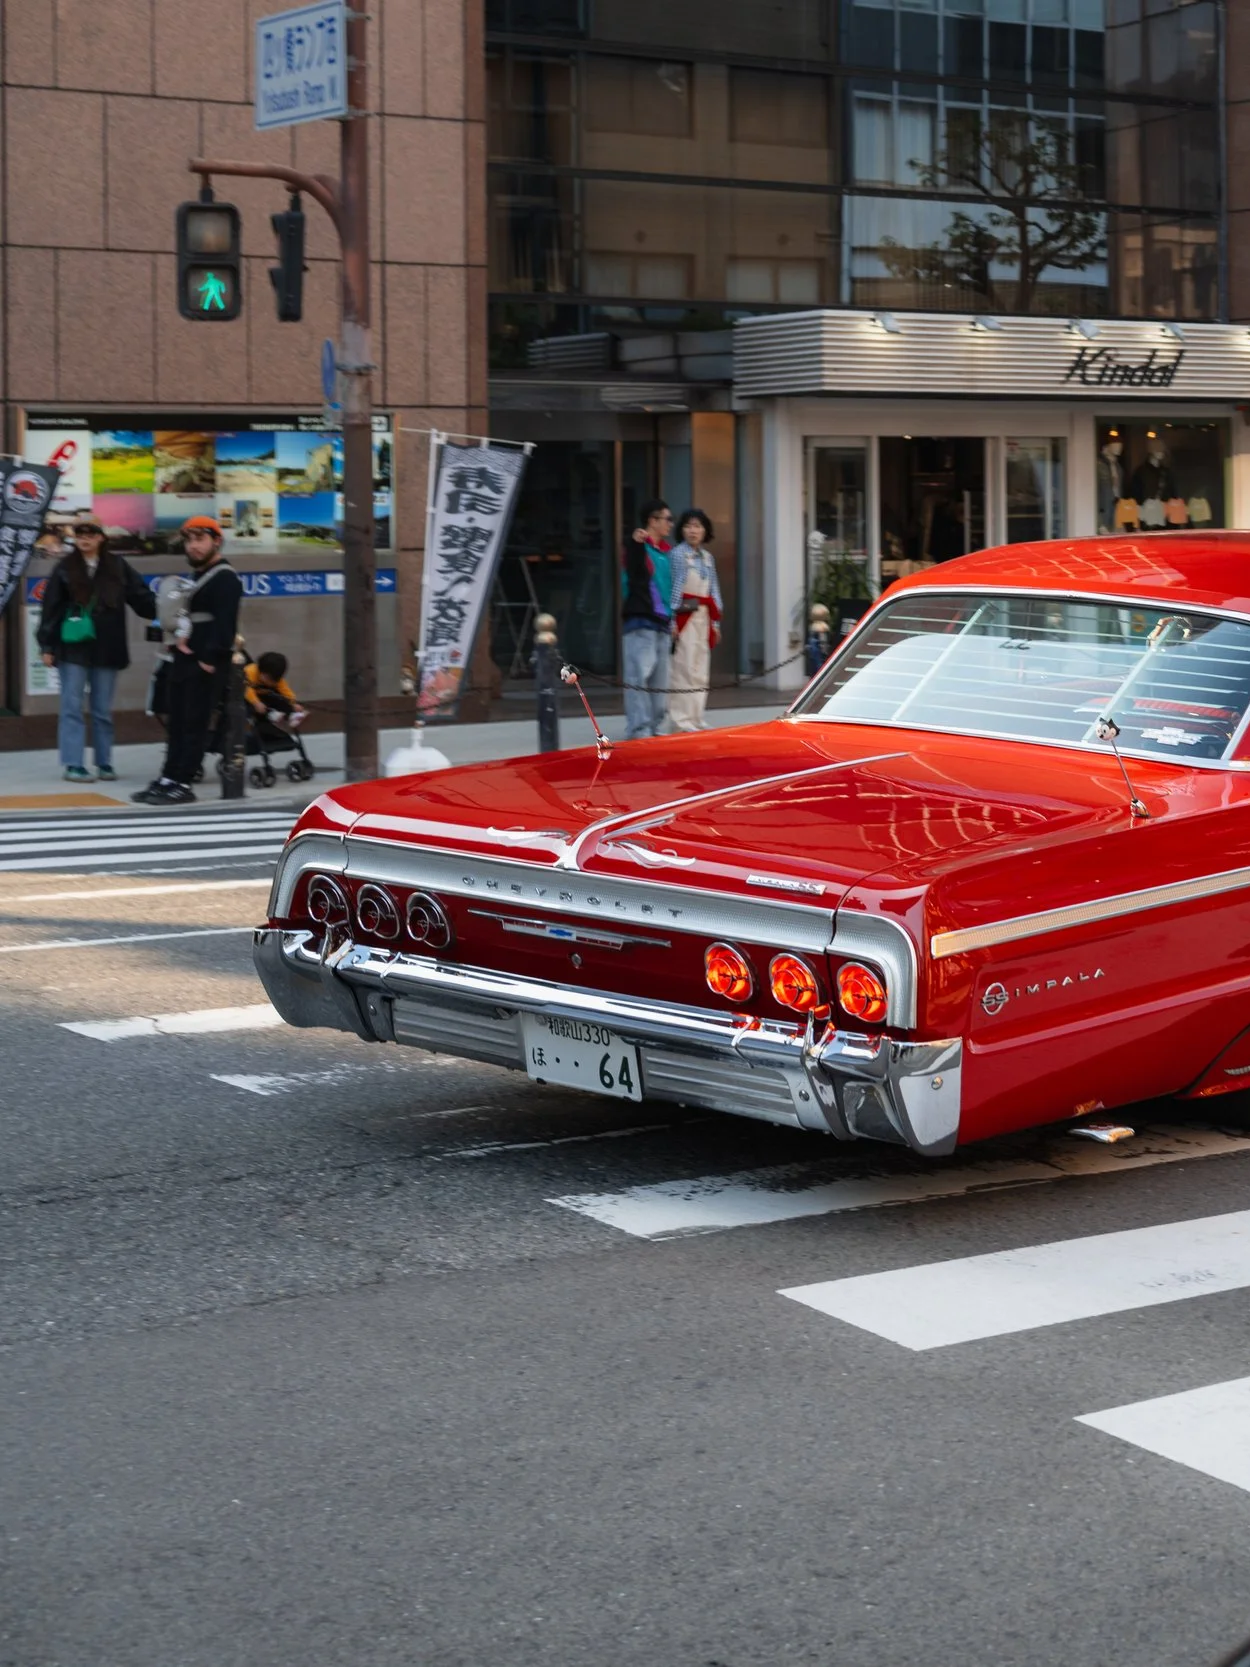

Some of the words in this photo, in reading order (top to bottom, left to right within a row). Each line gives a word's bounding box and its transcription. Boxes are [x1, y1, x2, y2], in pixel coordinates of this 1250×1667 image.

[1062, 346, 1186, 388] Kindal
[461, 875, 683, 919] CHEVROLET
[1014, 968, 1105, 998] IMPALA
[532, 1047, 547, 1066] ほ
